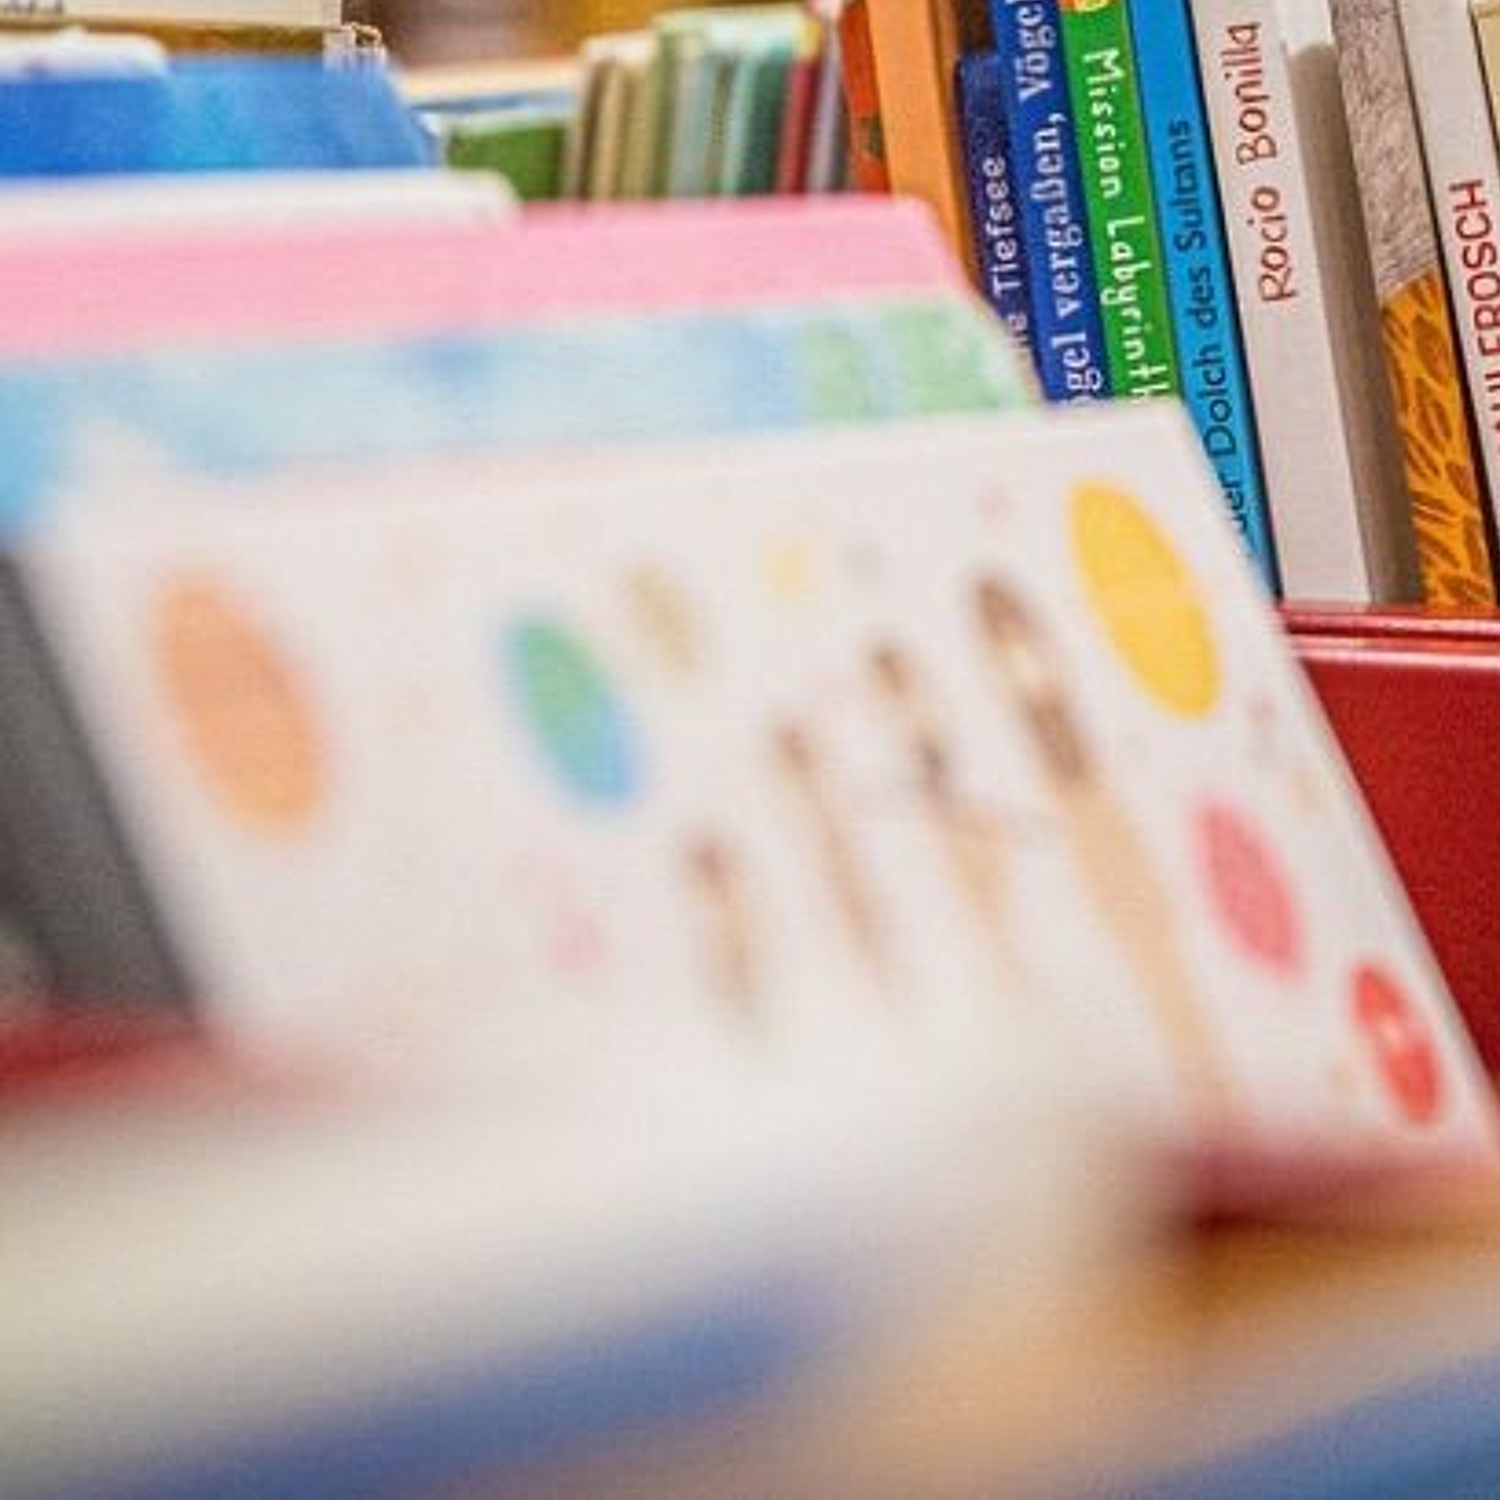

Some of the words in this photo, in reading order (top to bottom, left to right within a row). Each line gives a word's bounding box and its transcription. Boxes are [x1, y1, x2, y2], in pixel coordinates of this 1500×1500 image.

[1082, 47, 1127, 199] Mission
[1221, 21, 1278, 165] Bonilla
[981, 156, 1022, 296] Tiefsee
[1031, 112, 1084, 319] vergaßen,
[1168, 119, 1208, 253] Sultans
[1187, 266, 1219, 329] des
[1192, 344, 1238, 455] Dolch
